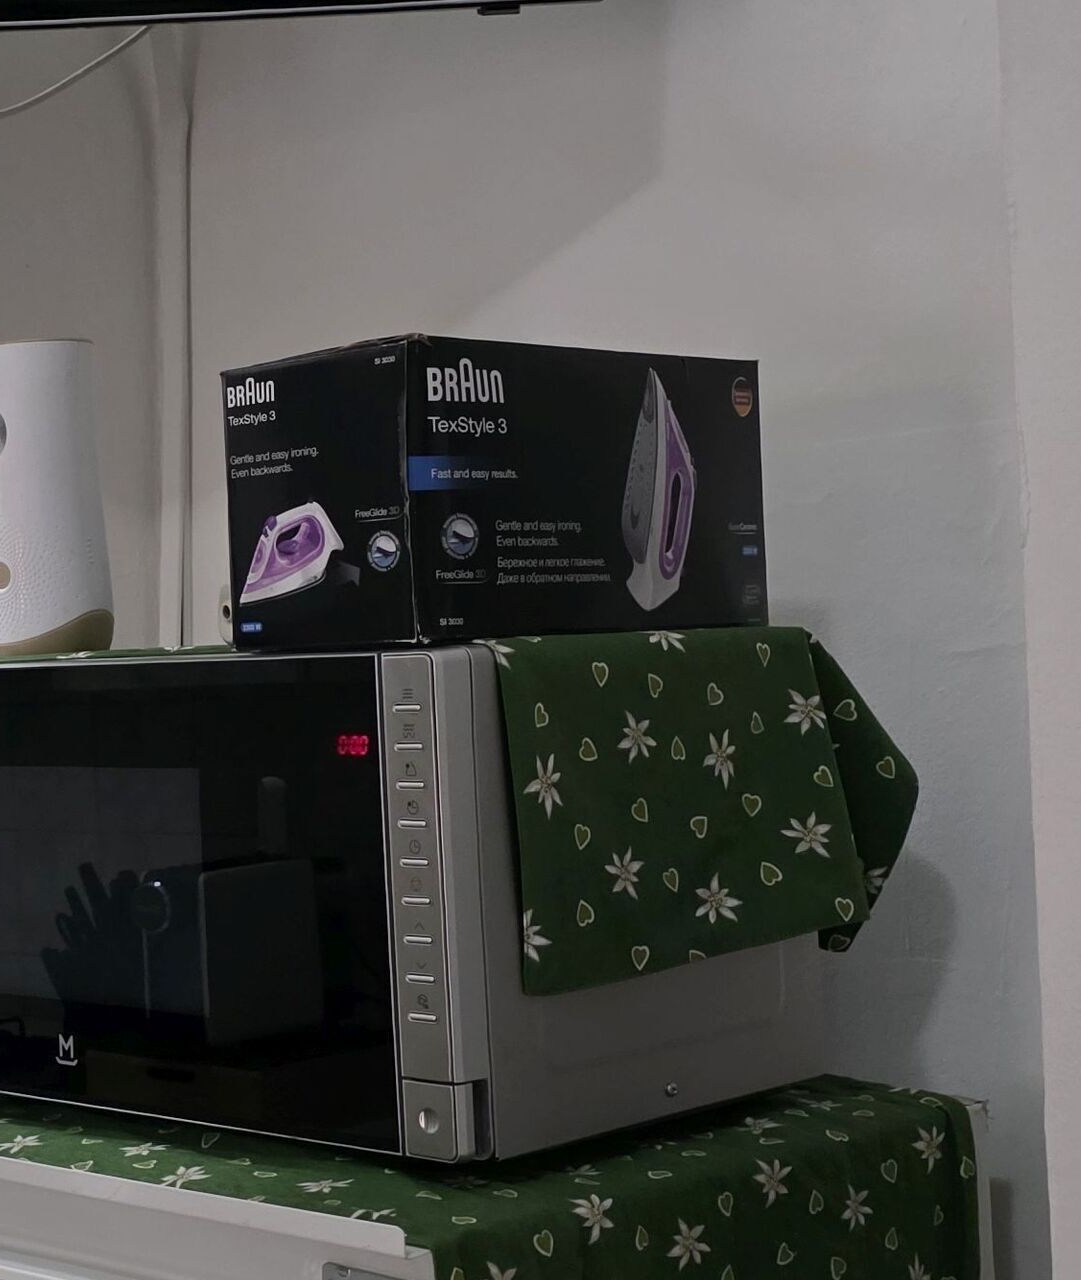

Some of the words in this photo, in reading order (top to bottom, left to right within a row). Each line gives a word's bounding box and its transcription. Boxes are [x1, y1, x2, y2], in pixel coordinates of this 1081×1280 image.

[426, 358, 504, 404] BRAUN
[226, 377, 275, 409] BRAUN
[227, 412, 268, 427] TexStyle
[269, 410, 276, 421] 3
[427, 416, 495, 437] TexStyle
[498, 418, 508, 434] 3
[255, 450, 270, 463] and
[431, 468, 451, 479] Fast
[453, 468, 470, 479] and
[471, 470, 490, 481] easy
